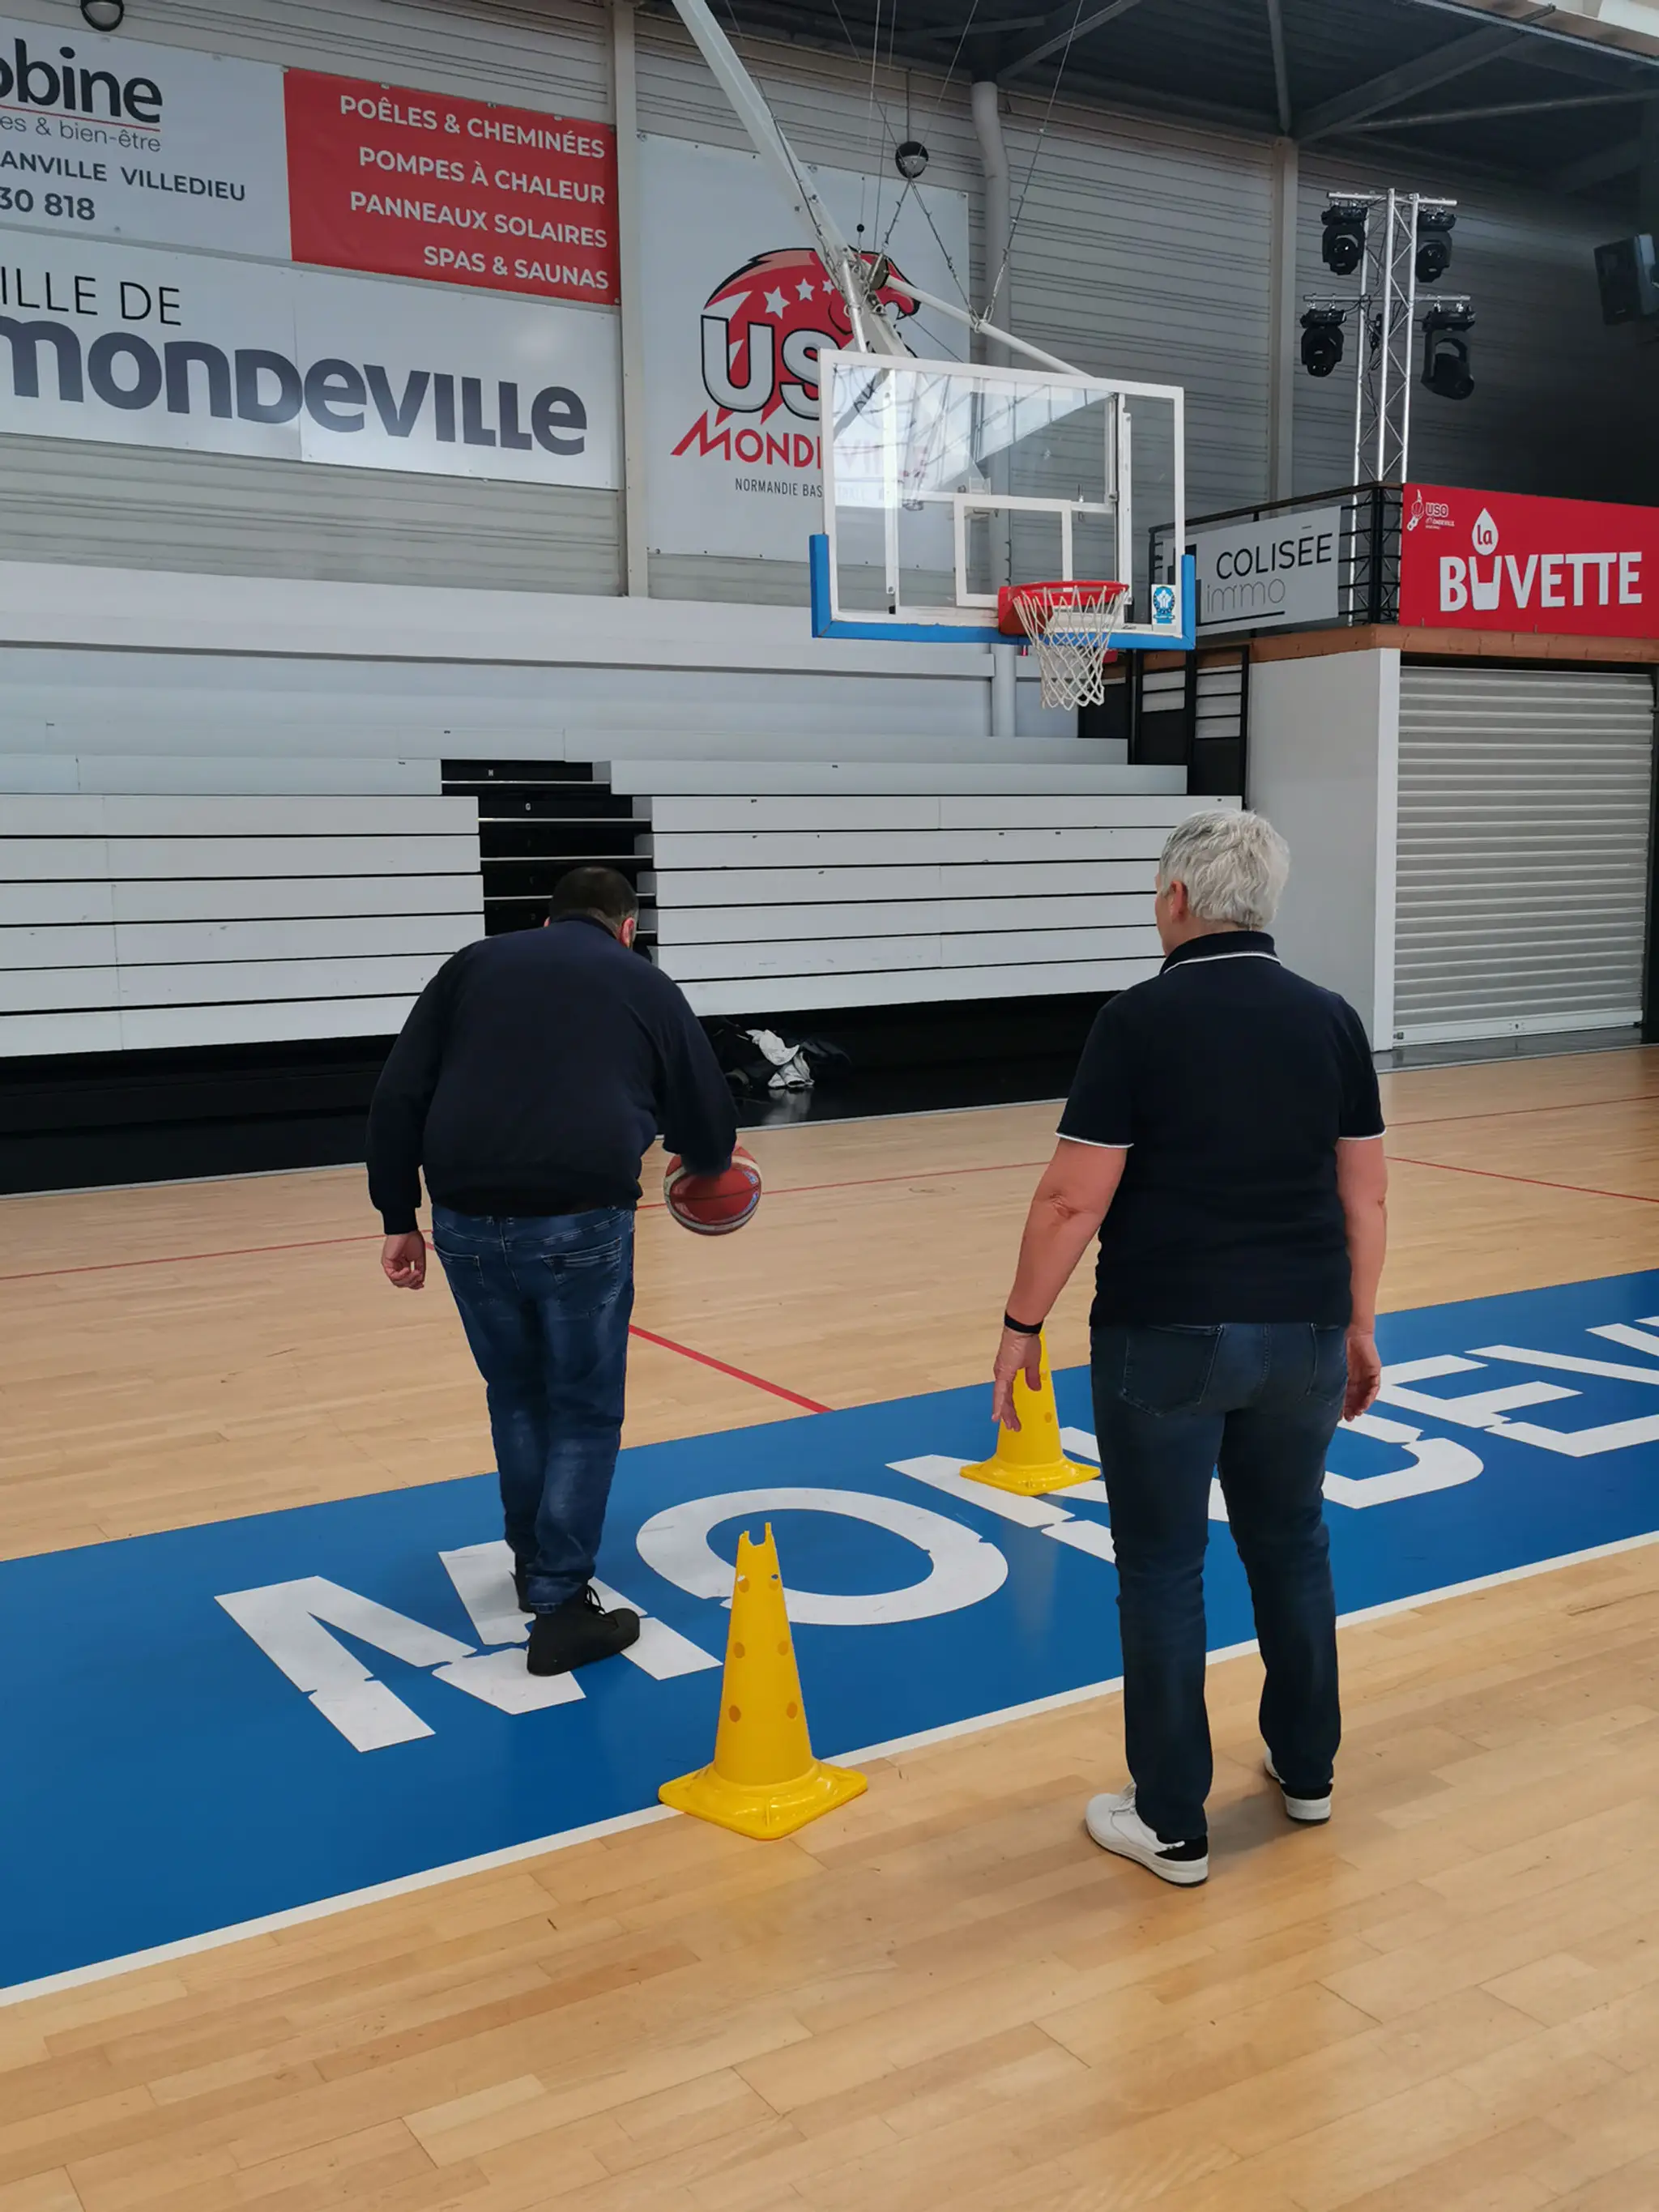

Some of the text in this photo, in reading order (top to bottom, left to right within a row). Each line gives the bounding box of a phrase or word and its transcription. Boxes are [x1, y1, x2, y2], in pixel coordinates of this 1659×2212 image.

[35, 117, 53, 137] &
[59, 120, 162, 153] bien-être
[340, 95, 605, 159] POÊLES & CHEMINÉES
[0, 150, 246, 202] ANVILLE VILLEDIEU
[359, 147, 606, 205] POMPES À CHALEUR
[44, 192, 96, 221] 818
[350, 191, 608, 249] PANNEAUX SOLAIRES
[424, 245, 609, 290] SPAS & SAUNAS
[119, 281, 182, 326] DE
[735, 477, 799, 497] NORMANDIE
[1477, 523, 1494, 546] la
[1206, 578, 1286, 614] immo
[1439, 551, 1644, 613] BUVETTE
